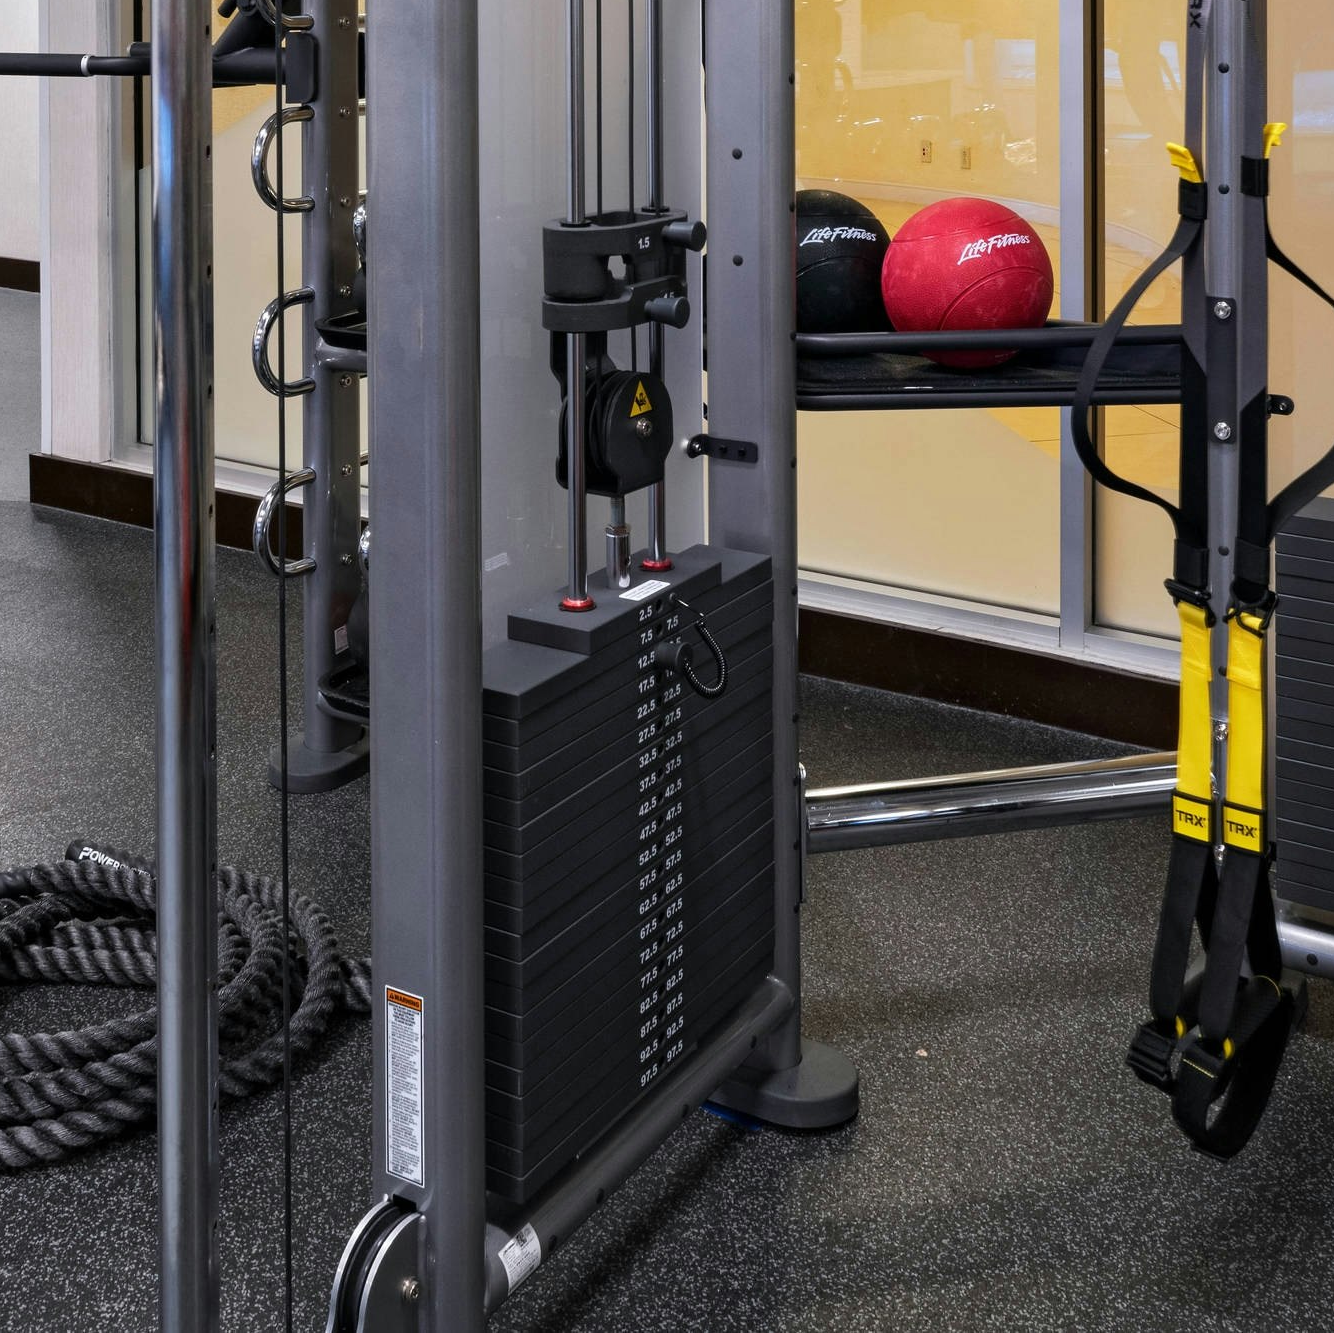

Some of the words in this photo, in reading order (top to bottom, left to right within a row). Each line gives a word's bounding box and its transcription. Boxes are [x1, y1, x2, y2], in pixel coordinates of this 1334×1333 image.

[637, 236, 650, 249] 1.5
[639, 605, 653, 622] 2.5
[640, 629, 653, 645] 7.5
[666, 614, 679, 631] 7.5
[637, 650, 655, 669] 12.5
[637, 699, 656, 720] 22.5
[664, 683, 681, 702] 22.5
[638, 675, 655, 694] 17.5
[638, 723, 656, 744] 27.5
[665, 707, 681, 727] 27.5
[639, 747, 657, 769] 32.5
[665, 730, 683, 751] 32.5
[639, 771, 657, 793] 37.5
[665, 754, 682, 774] 37.5
[638, 795, 657, 816] 42.5
[664, 778, 682, 798] 42.5
[639, 820, 657, 840] 47.5
[665, 802, 682, 821] 47.5
[1175, 809, 1204, 829] TRX
[1226, 819, 1256, 838] TRX
[639, 843, 657, 866] 52.5
[665, 825, 683, 846] 52.5
[639, 869, 657, 891] 57.5
[665, 849, 682, 870] 57.5
[639, 892, 658, 915] 62.5
[665, 873, 683, 895] 62.5
[639, 917, 657, 940] 67.5
[666, 897, 683, 919] 67.5
[639, 941, 658, 964] 72.5
[666, 920, 684, 943] 72.5
[640, 966, 658, 989] 77.5
[666, 944, 684, 966] 77.5
[639, 990, 658, 1014] 82.5
[666, 968, 684, 991] 82.5
[640, 1015, 658, 1038] 87.5
[666, 992, 683, 1015] 87.5
[640, 1038, 658, 1063] 92.5
[666, 1015, 684, 1039] 92.5
[640, 1063, 658, 1087] 97.5
[666, 1039, 683, 1062] 97.5
